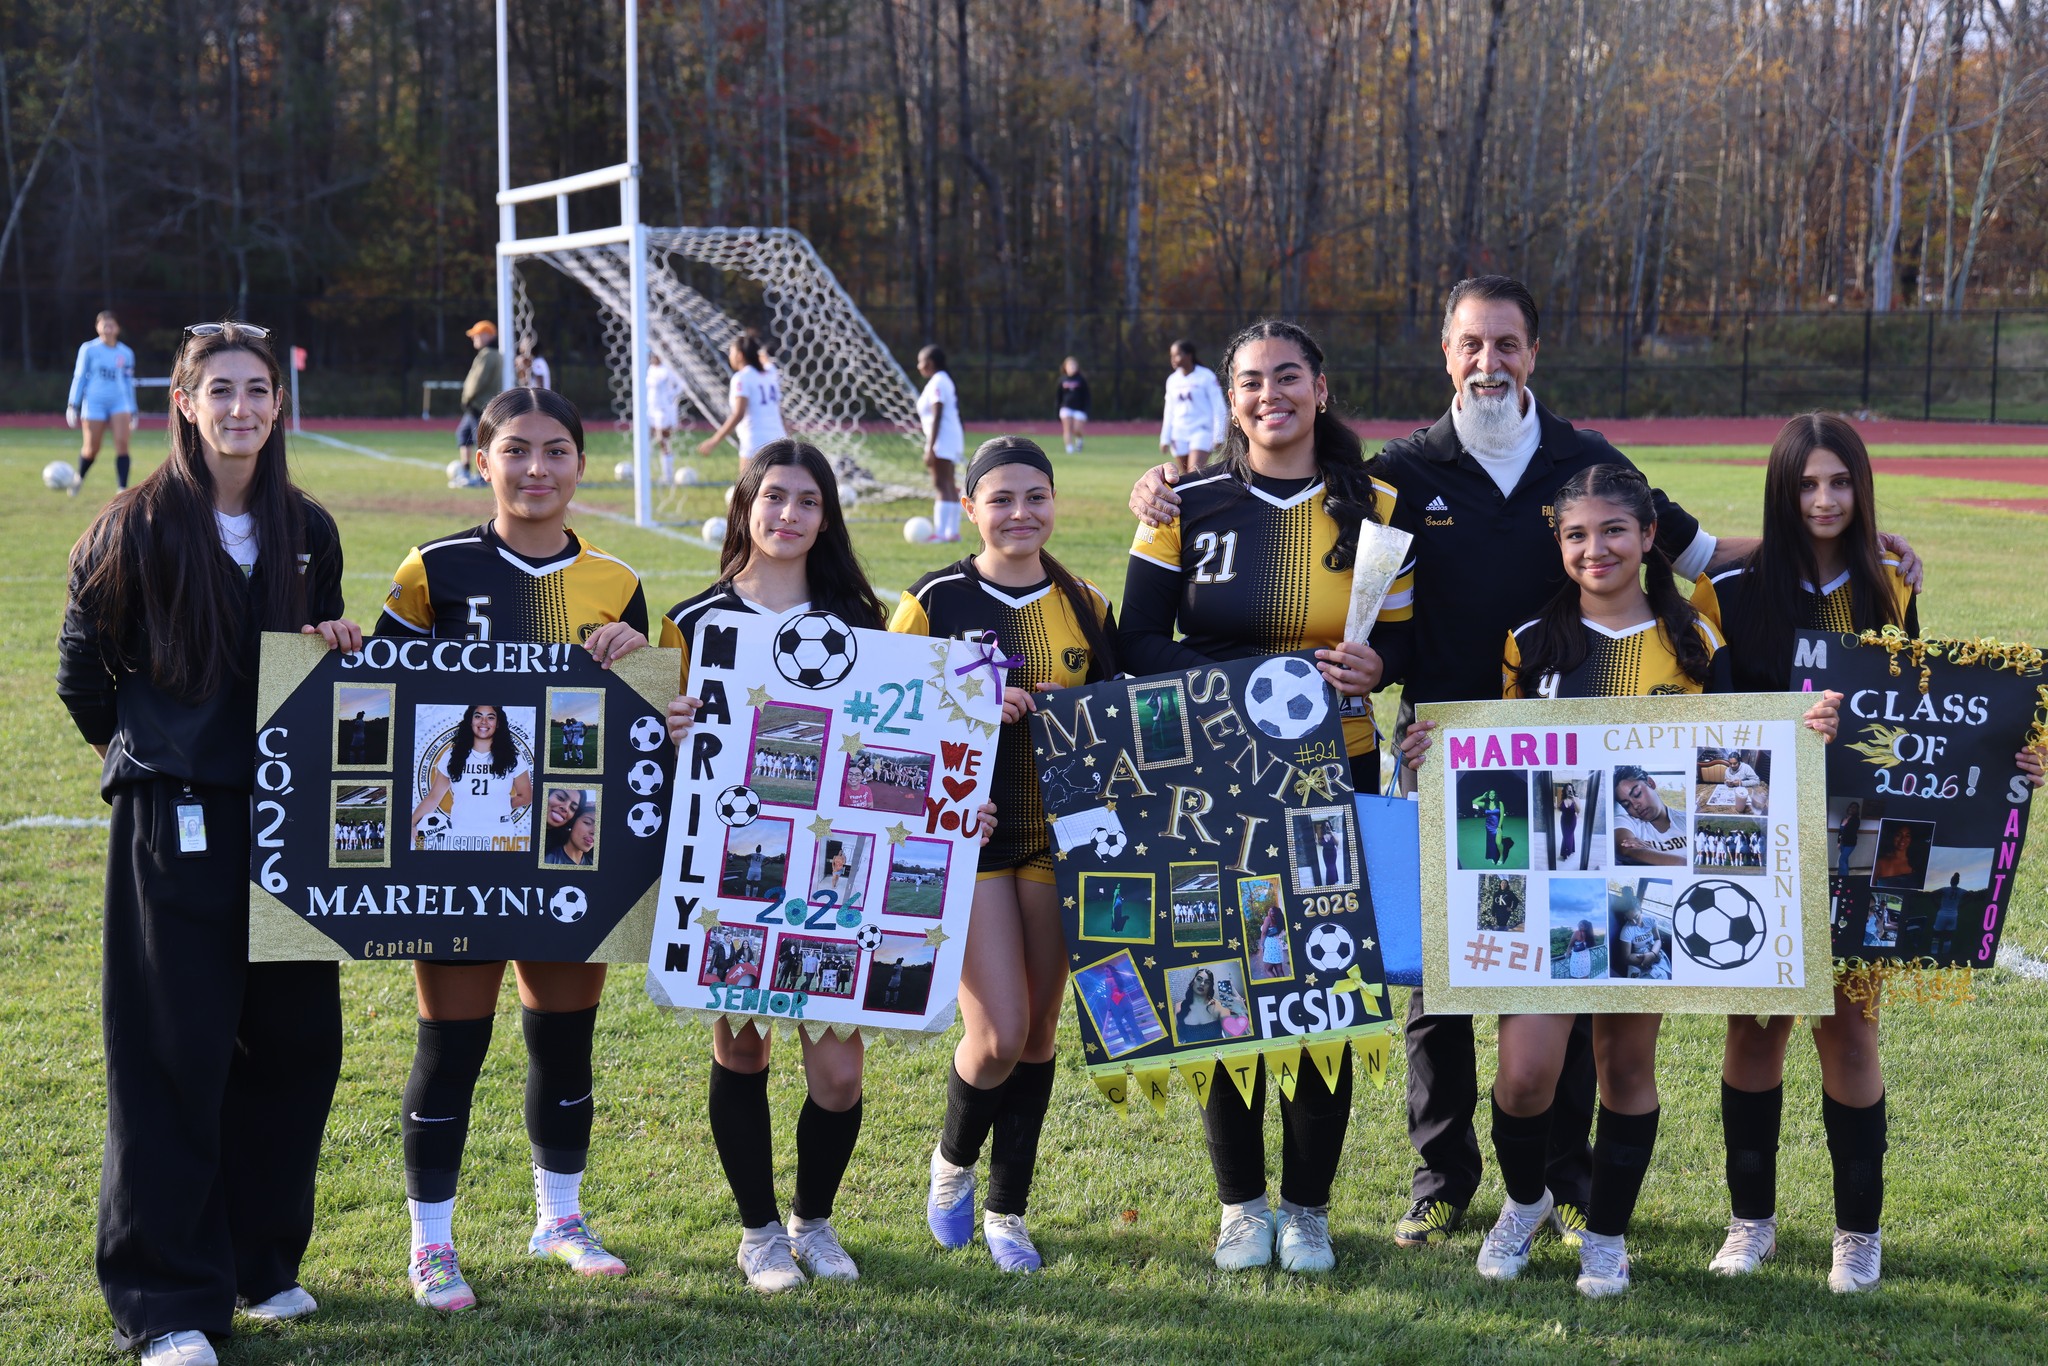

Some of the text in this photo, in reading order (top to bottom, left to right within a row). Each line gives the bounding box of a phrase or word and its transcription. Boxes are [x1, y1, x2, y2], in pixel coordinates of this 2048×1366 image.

[1425, 516, 1454, 526] Coach
[1194, 530, 1238, 584] 21
[466, 595, 492, 641] 5
[341, 638, 571, 673] SOCCCER!!
[843, 679, 925, 736] #21
[1850, 689, 1989, 726] CLASS
[940, 740, 982, 777] WE
[1294, 740, 1341, 766] #21
[1449, 732, 1578, 769] MARII
[1892, 733, 1948, 765] OF
[471, 779, 489, 796] 21
[664, 624, 739, 973] MARILYN
[1032, 694, 1270, 876] MARI
[924, 797, 981, 840] YOU
[1977, 774, 2030, 961] SANTOS
[306, 885, 546, 917] MARELYN!
[756, 885, 863, 931] 2026
[1302, 893, 1359, 919] 2026
[1774, 823, 1796, 986] SENIOR
[364, 936, 468, 958] Captain 21
[1463, 933, 1543, 972] #21
[706, 981, 809, 1019] SENIOR
[1257, 986, 1356, 1040] FCSD
[1108, 1048, 1381, 1105] CAPTAIN
